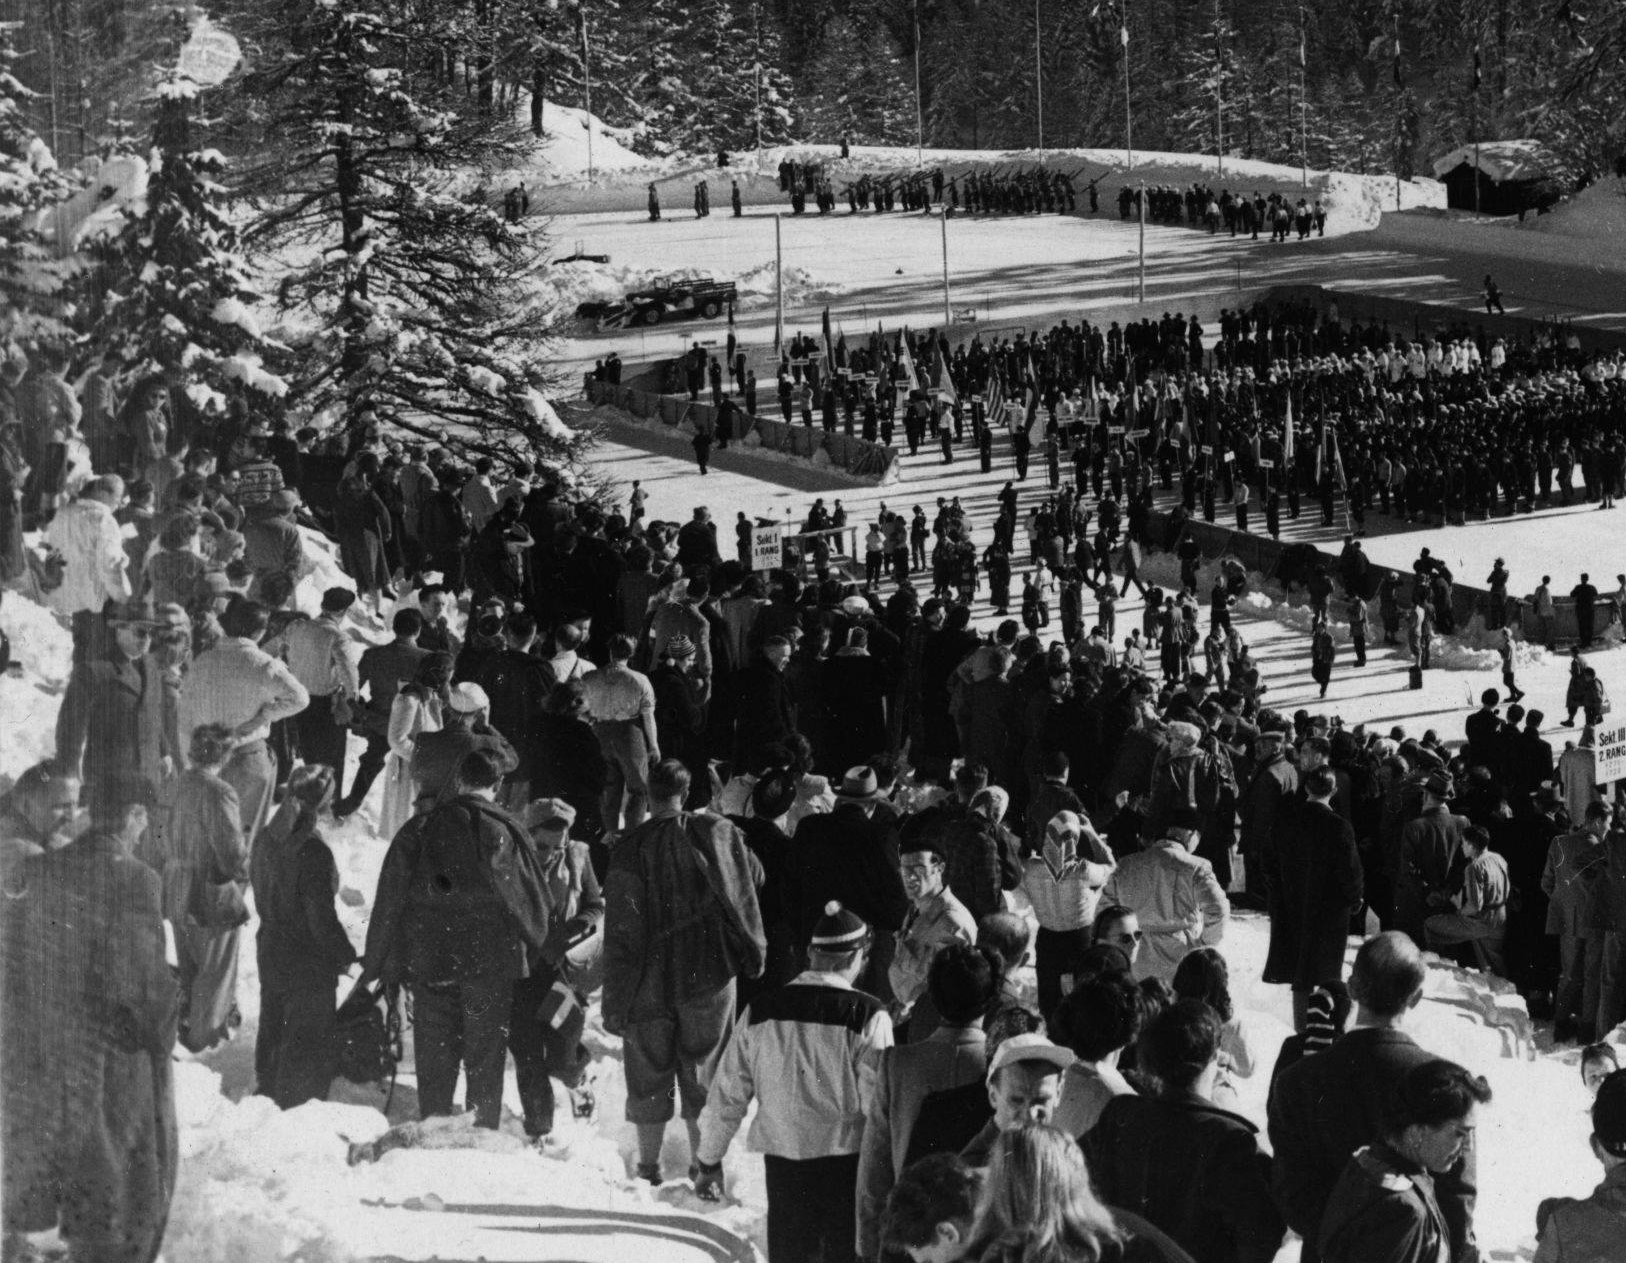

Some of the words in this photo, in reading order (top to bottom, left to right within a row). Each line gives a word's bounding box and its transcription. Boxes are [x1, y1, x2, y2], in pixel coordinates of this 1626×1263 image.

[760, 545, 779, 556] RANG
[1618, 727, 1626, 742] III
[1606, 745, 1626, 760] RANG
